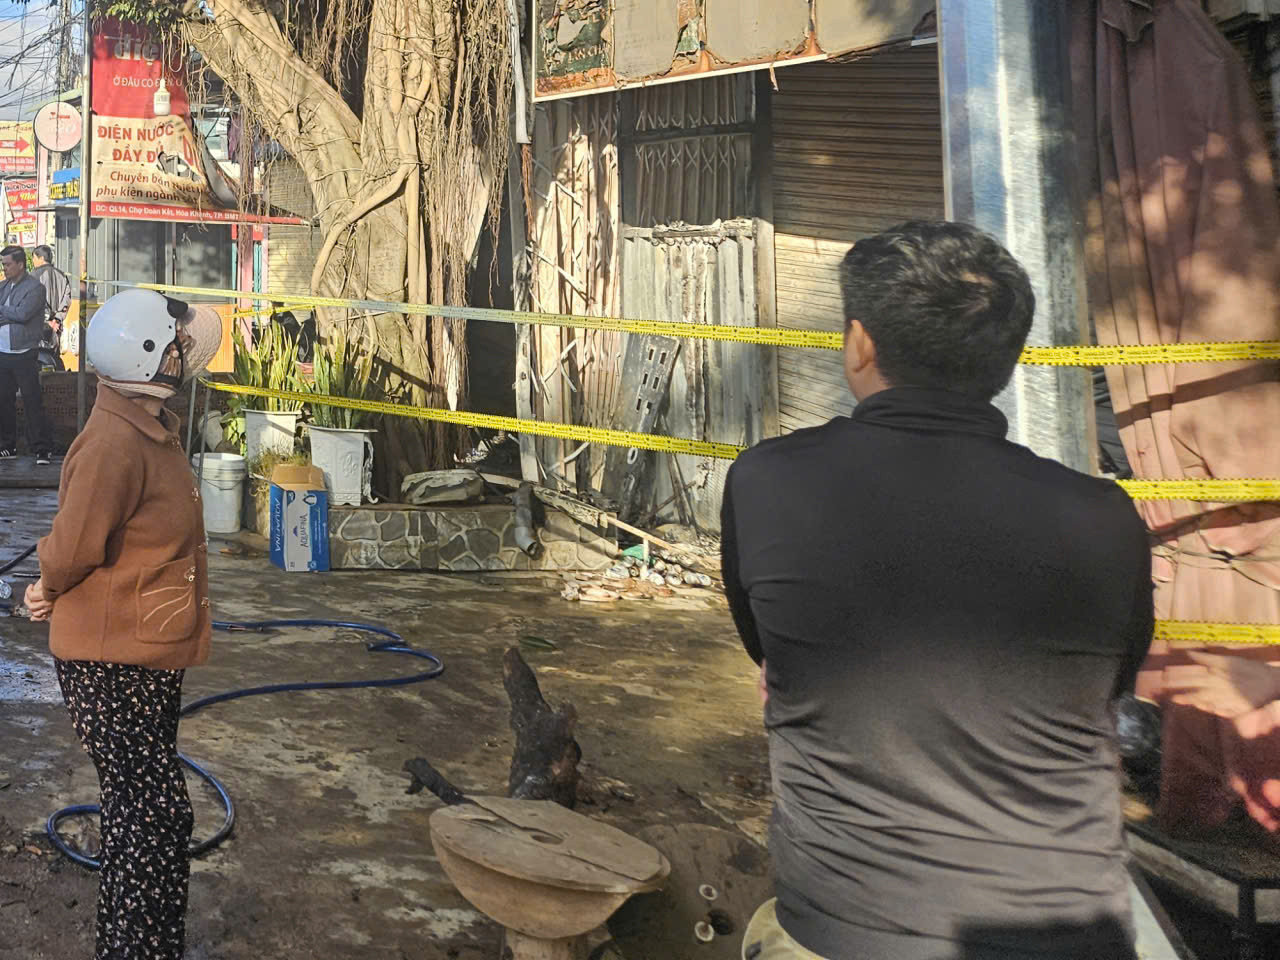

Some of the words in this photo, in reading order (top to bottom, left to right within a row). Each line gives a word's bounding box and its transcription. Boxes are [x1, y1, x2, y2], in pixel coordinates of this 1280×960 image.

[97, 124, 132, 143] ĐIỆN
[137, 121, 175, 142] NƯỚC
[112, 144, 143, 162] ĐẦY
[110, 171, 149, 185] Chuyên
[96, 186, 118, 199] phụ
[120, 186, 143, 200] kiện
[146, 190, 180, 202] ngành
